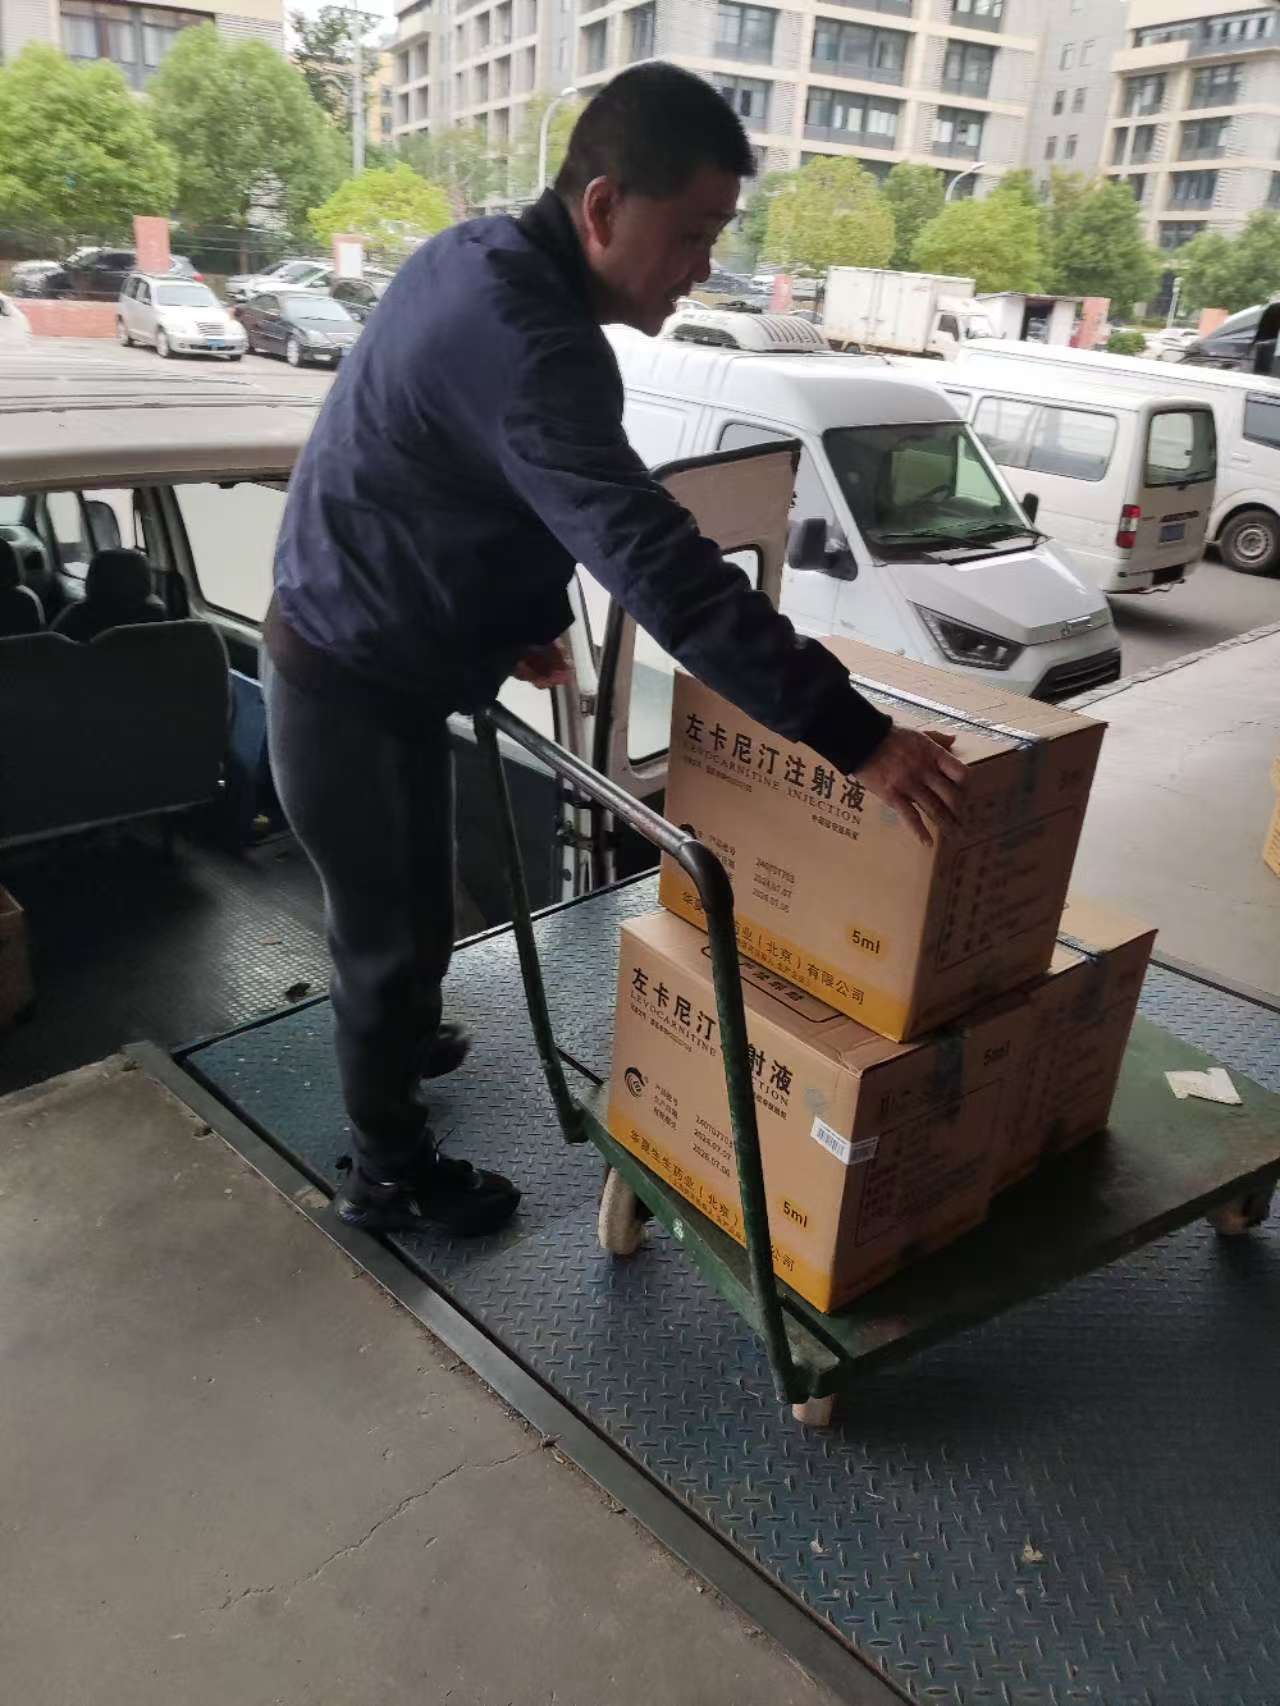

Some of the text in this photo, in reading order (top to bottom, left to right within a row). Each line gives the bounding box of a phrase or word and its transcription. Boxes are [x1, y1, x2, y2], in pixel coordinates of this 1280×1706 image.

[685, 713, 866, 812] 左卡尼汀注射液
[786, 787, 862, 826] INJECTION
[851, 928, 881, 955] 5ml
[630, 990, 717, 1057] LEVOCARNITINE
[632, 967, 793, 1095] 左卡尼汀射液
[783, 1200, 809, 1229] 5ml
